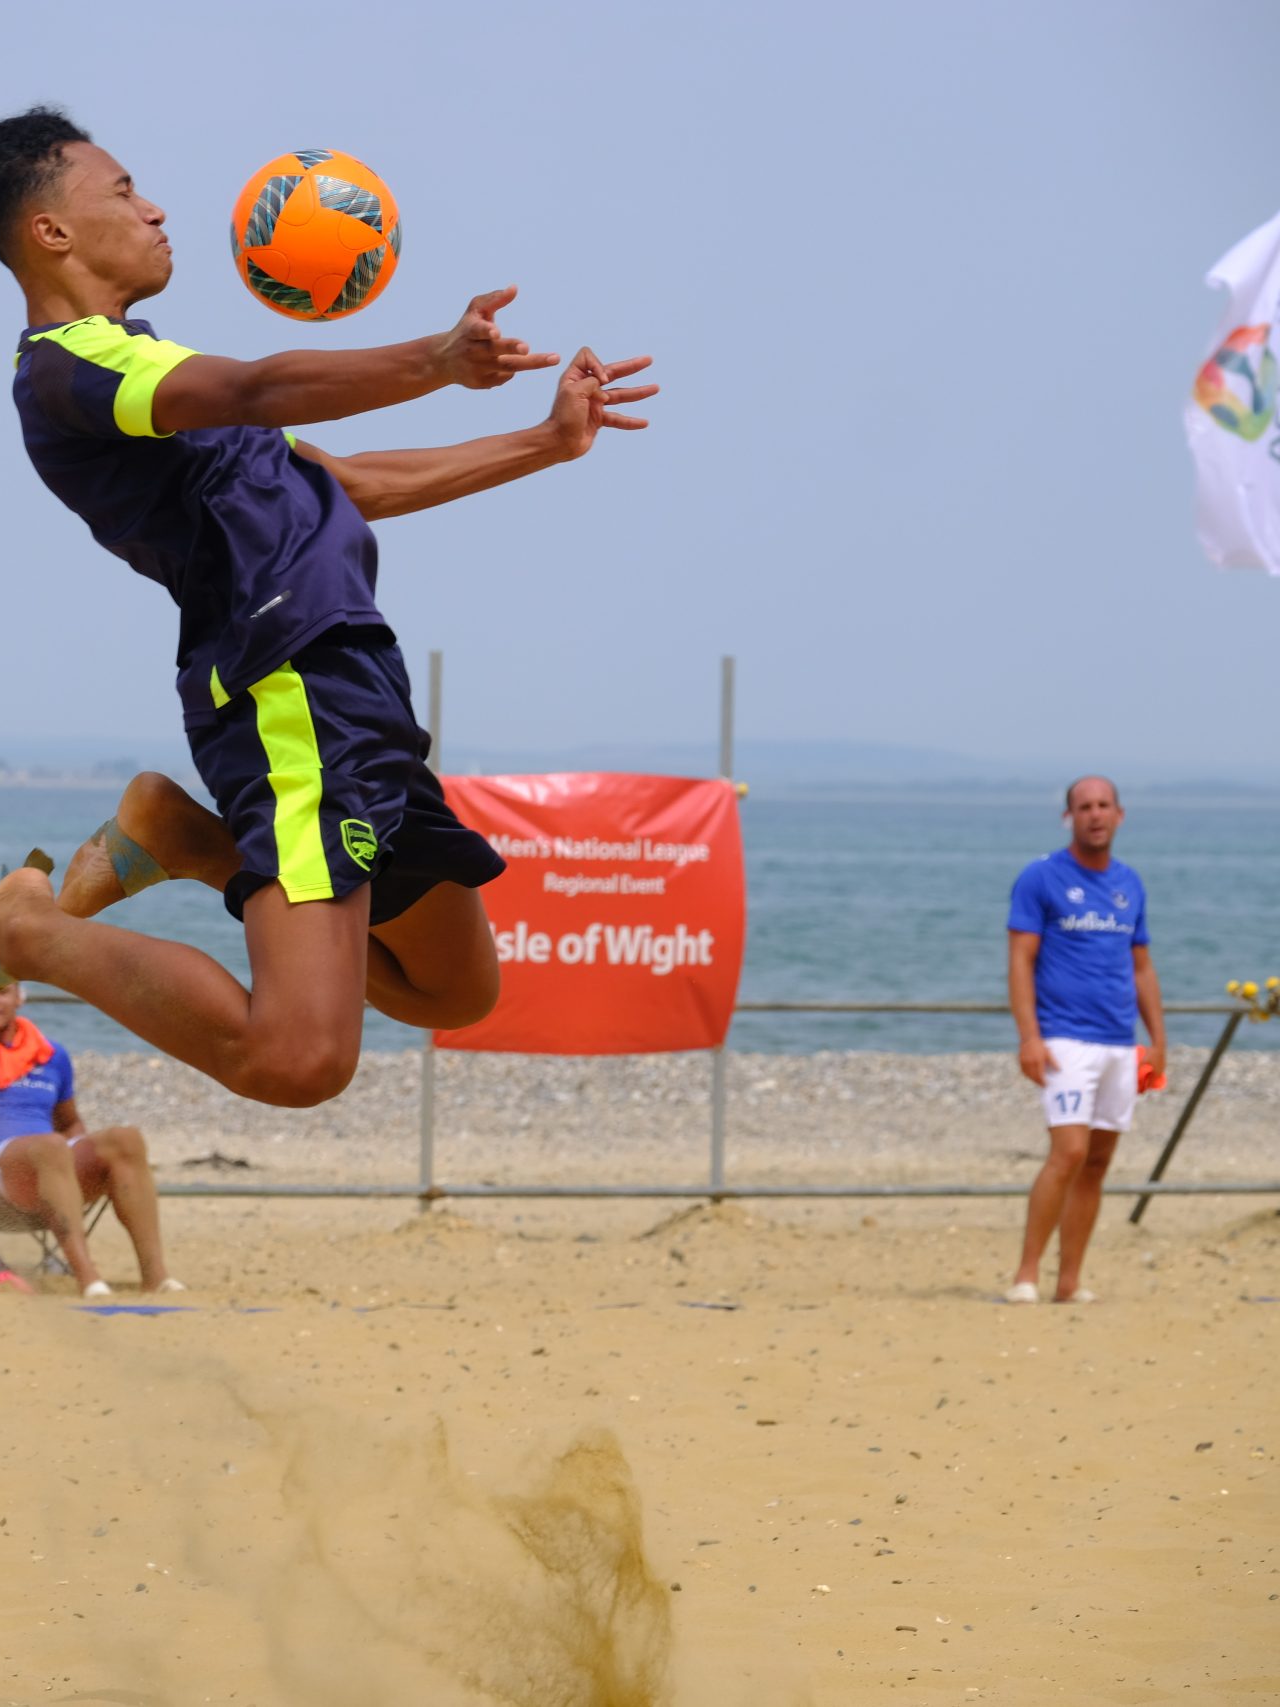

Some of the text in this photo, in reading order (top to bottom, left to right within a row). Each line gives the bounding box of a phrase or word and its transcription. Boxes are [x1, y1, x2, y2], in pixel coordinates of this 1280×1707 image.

[489, 834, 711, 867] Men's National League
[543, 871, 665, 898] Regional Event
[557, 922, 604, 965] of
[604, 924, 715, 976] Wight
[1054, 1090, 1083, 1115] 17
